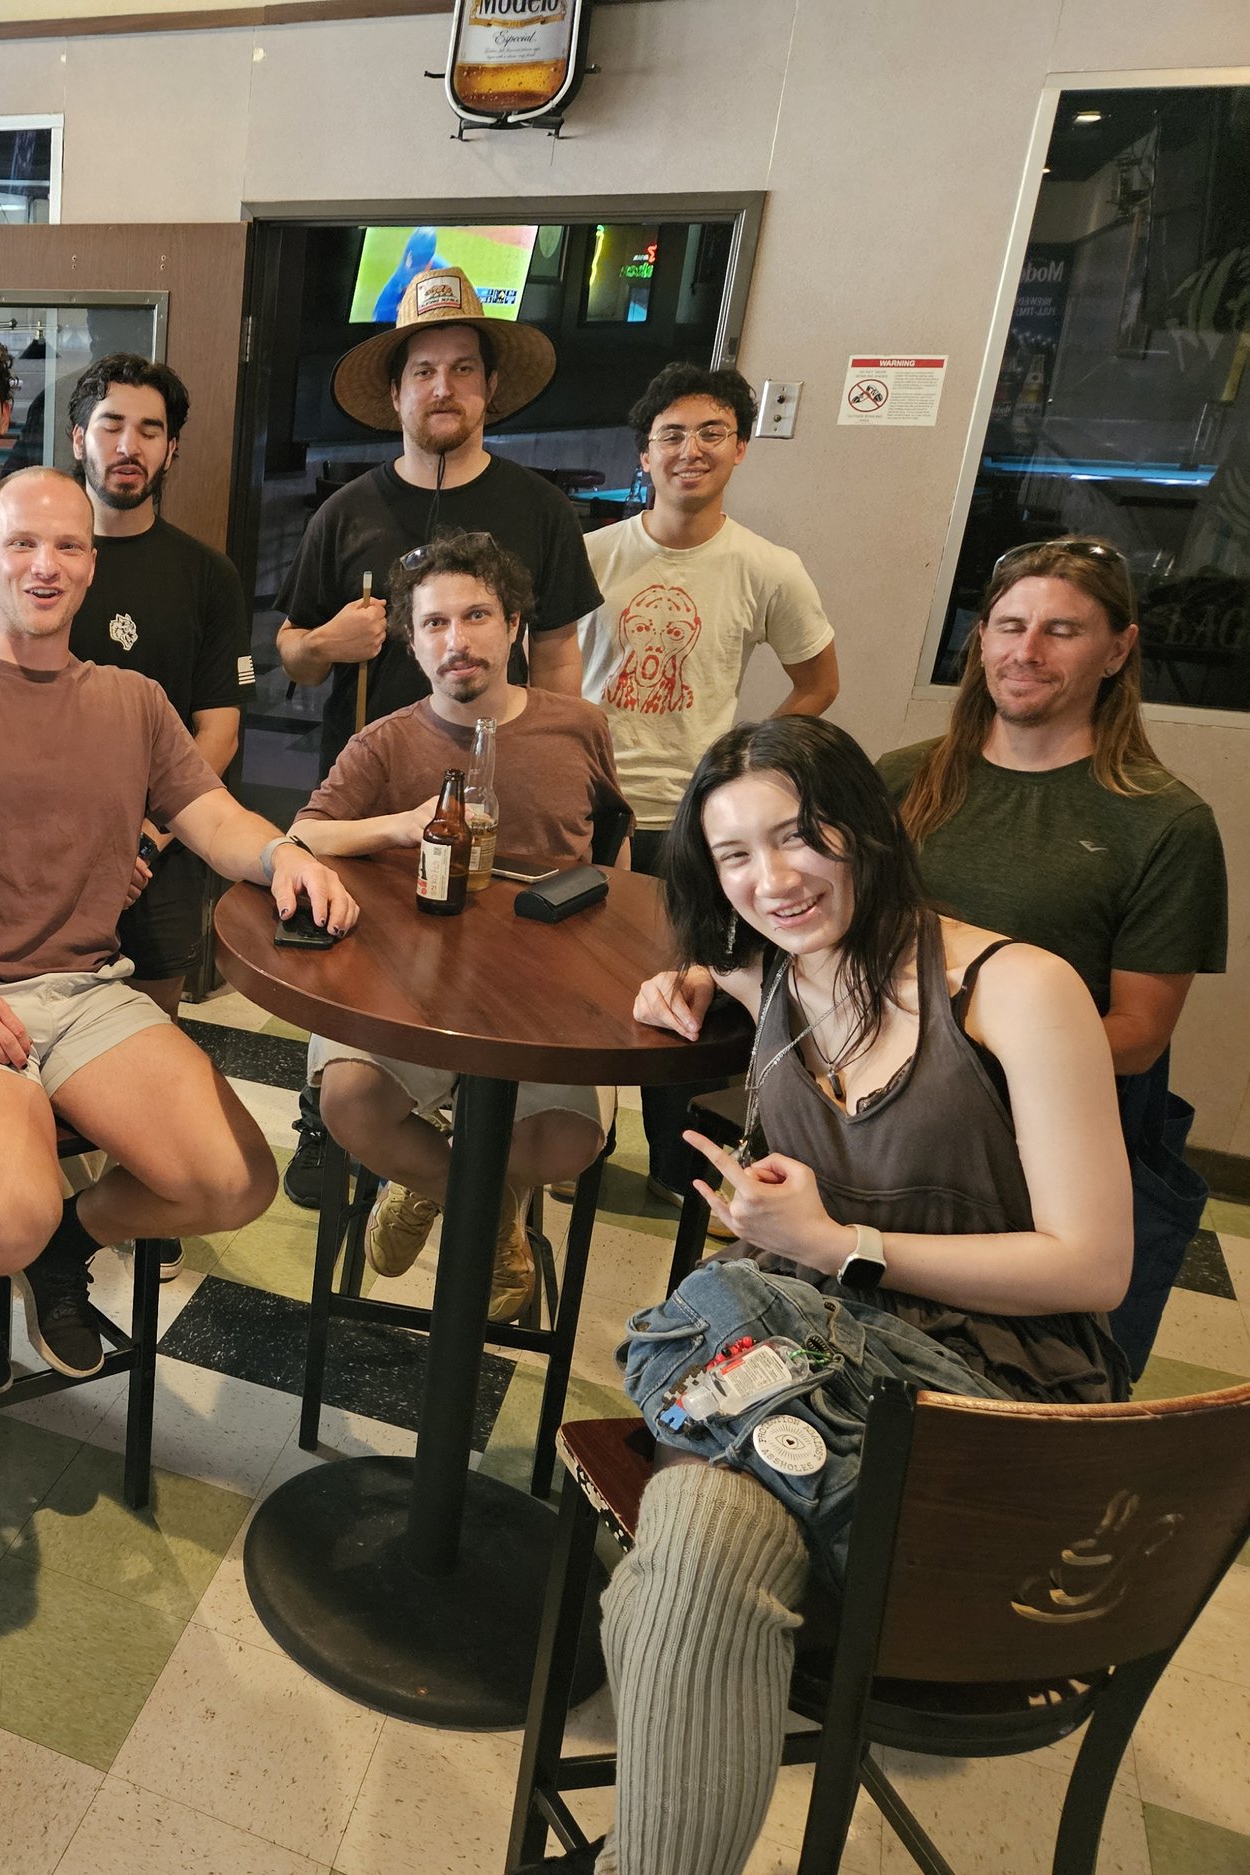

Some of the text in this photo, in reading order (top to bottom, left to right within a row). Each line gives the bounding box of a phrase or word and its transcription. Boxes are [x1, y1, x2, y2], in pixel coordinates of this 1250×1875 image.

[493, 30, 535, 47] Especial
[879, 359, 915, 367] WARNING
[803, 1425, 824, 1461] AGAINST
[762, 1449, 814, 1472] ASSHOLES
